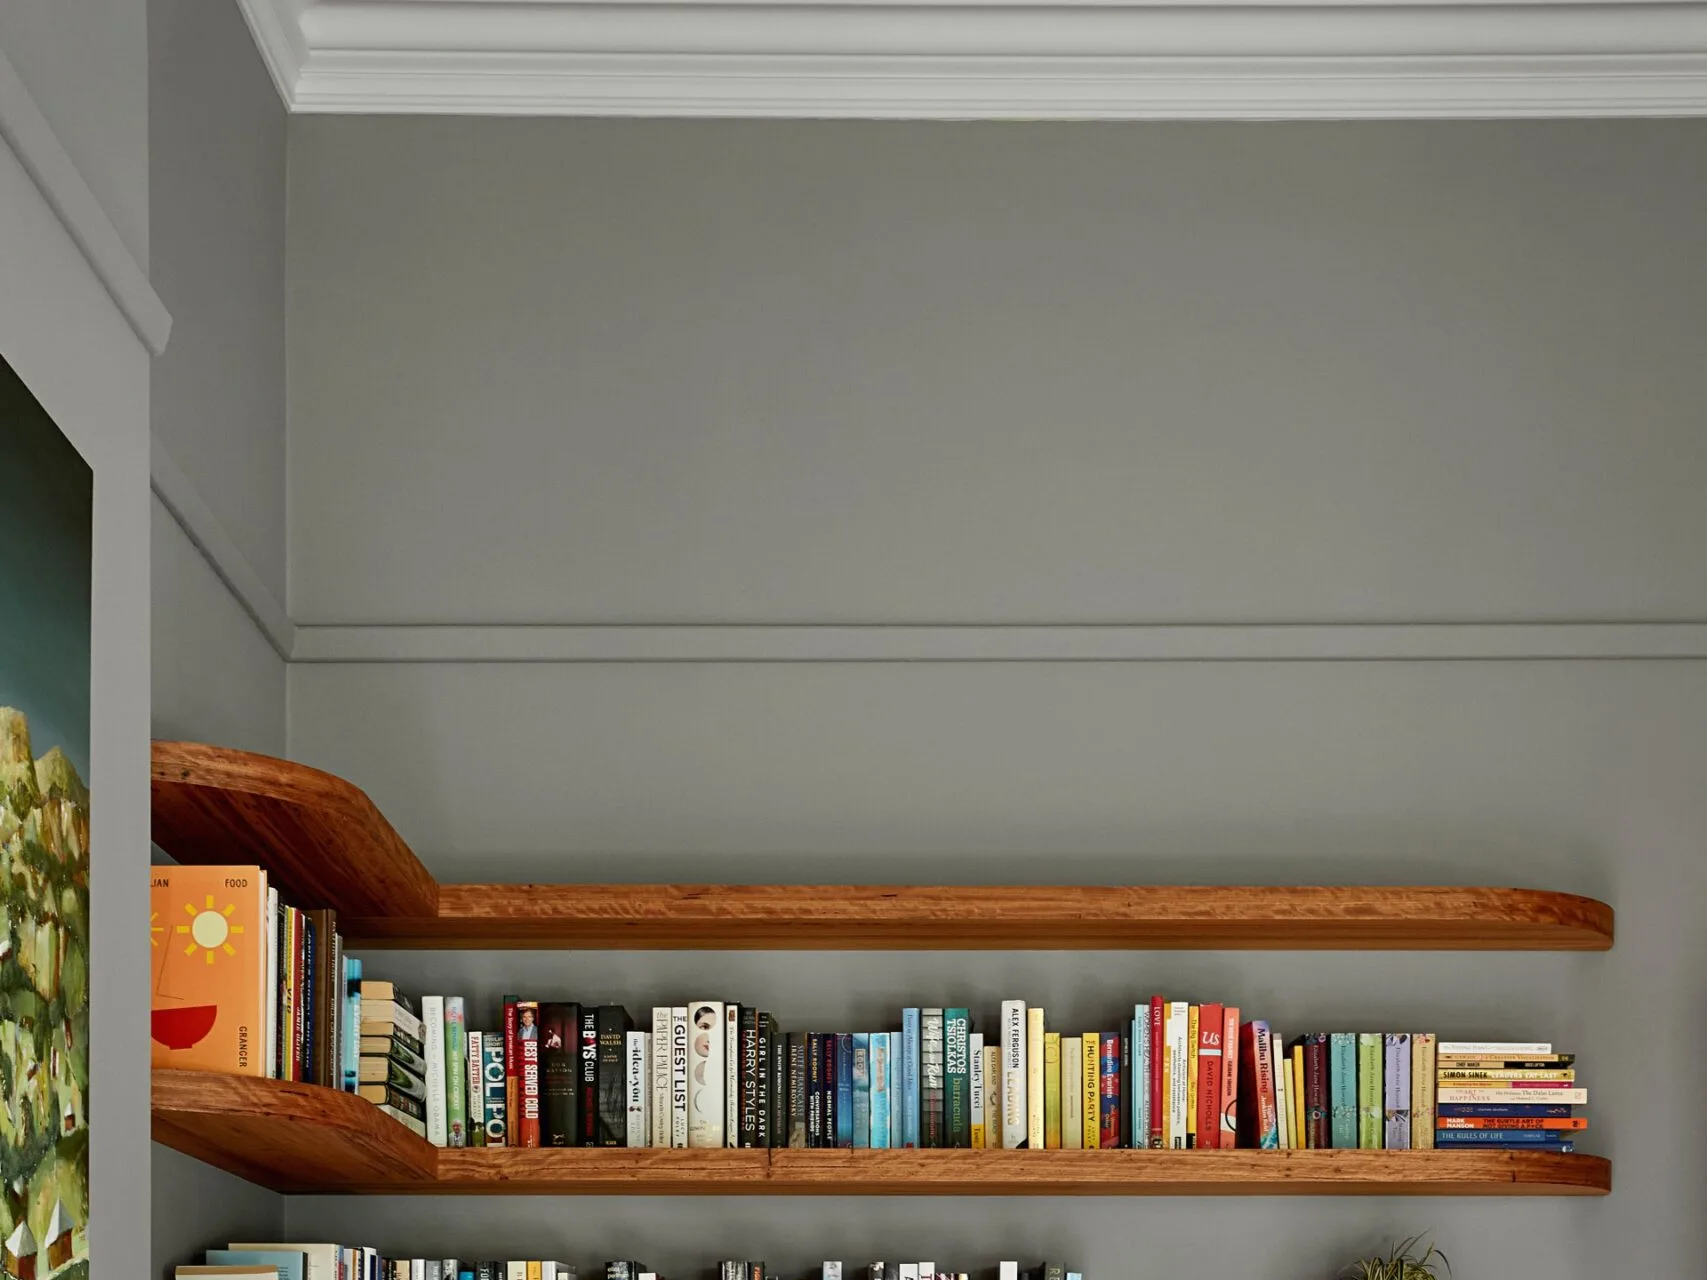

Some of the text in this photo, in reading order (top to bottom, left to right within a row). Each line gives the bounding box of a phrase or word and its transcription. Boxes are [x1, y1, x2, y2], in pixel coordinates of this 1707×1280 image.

[224, 878, 248, 888] FOOD
[238, 1025, 248, 1068] GRANGER
[429, 1007, 437, 1050] BECOMING
[585, 1014, 594, 1029] THE
[947, 1019, 956, 1073] TSIOLKAS
[957, 1018, 966, 1074] CHRISTOS
[472, 1060, 480, 1084] BATTER
[485, 1048, 504, 1096] POL
[524, 1041, 538, 1118] BEST SERVED COLD
[585, 1062, 594, 1082] CLUB
[656, 1019, 669, 1091] PAPER PALACE
[675, 1025, 685, 1112] GUEST LIST
[759, 1068, 765, 1078] IN
[972, 1050, 982, 1081] Stanley
[1257, 1028, 1269, 1093] Malibu Rising
[745, 1030, 755, 1131] HARRY STYLES
[953, 1078, 962, 1132] barracuda
[1007, 1072, 1019, 1125] LEADING
